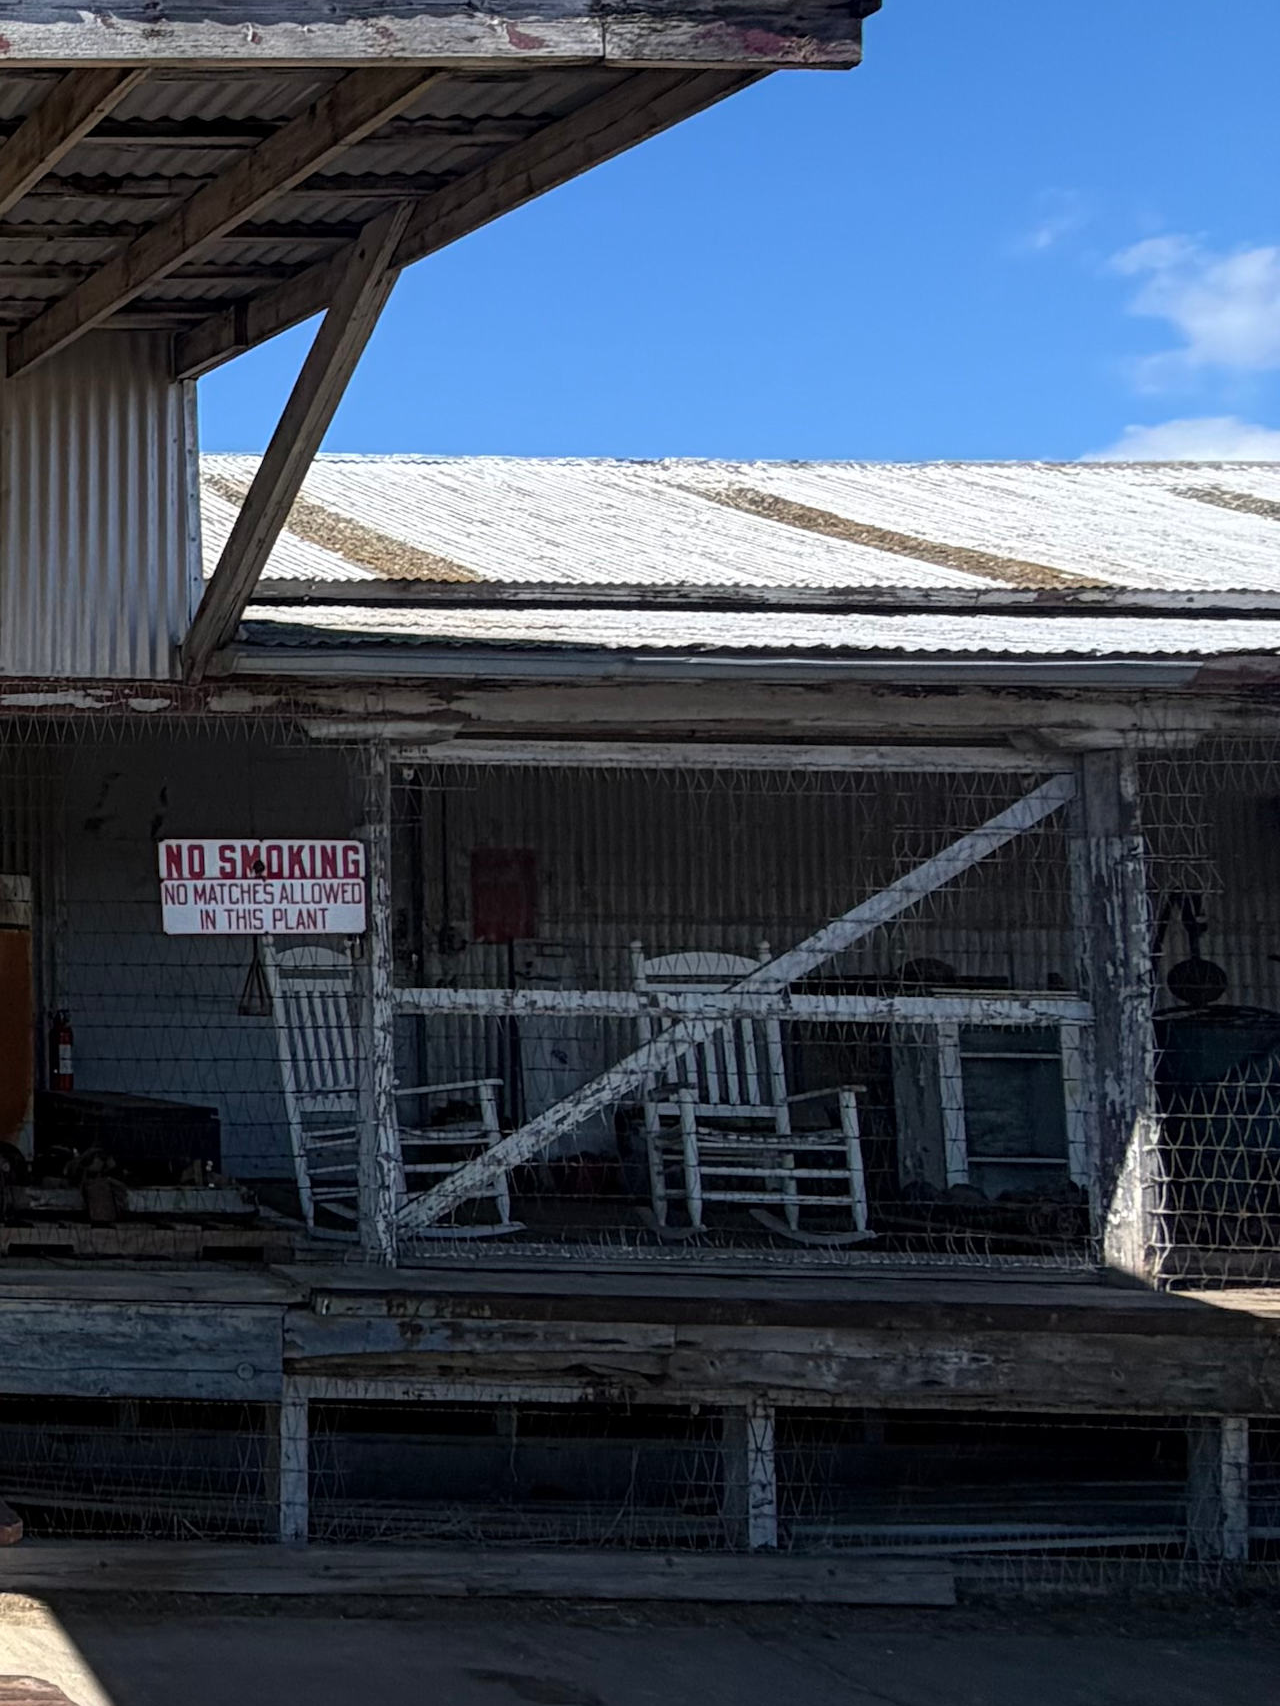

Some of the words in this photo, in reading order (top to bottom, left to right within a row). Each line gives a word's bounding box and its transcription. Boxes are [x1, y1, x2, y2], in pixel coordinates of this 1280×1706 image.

[165, 844, 205, 880] NO
[218, 844, 361, 880] SMOKING
[164, 882, 188, 906] NO
[193, 883, 275, 905] MATCHES
[279, 882, 363, 905] ALLOWED
[200, 908, 217, 931] IN
[223, 908, 265, 931] THIS
[272, 908, 329, 931] PLANT
